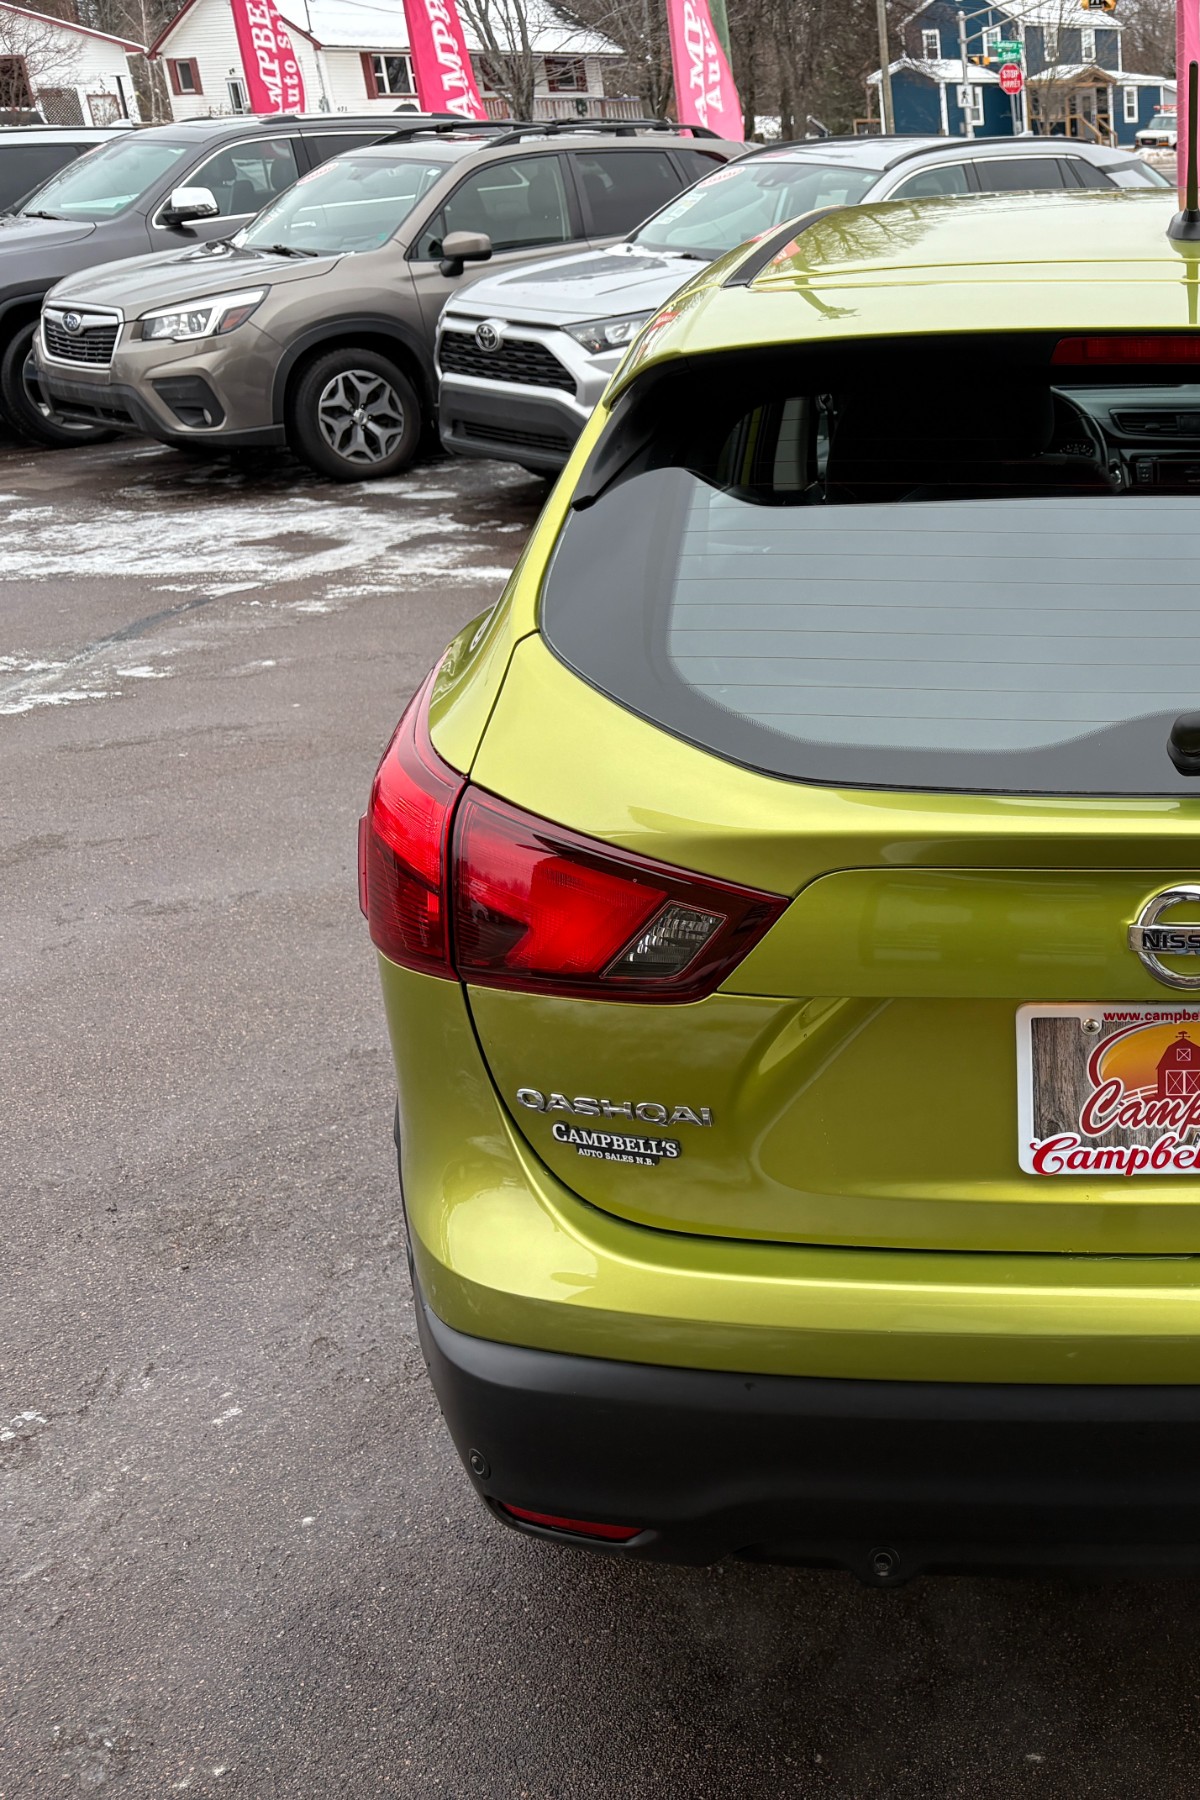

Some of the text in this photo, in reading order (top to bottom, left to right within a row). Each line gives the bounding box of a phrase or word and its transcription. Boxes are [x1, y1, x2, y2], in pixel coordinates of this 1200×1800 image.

[684, 0, 708, 129] AMP
[1002, 69, 1018, 79] STOP
[516, 1088, 714, 1127] QASHQAI
[552, 1122, 679, 1158] CAMPBELL'S
[577, 1148, 656, 1167] AUTO SALES N.B.
